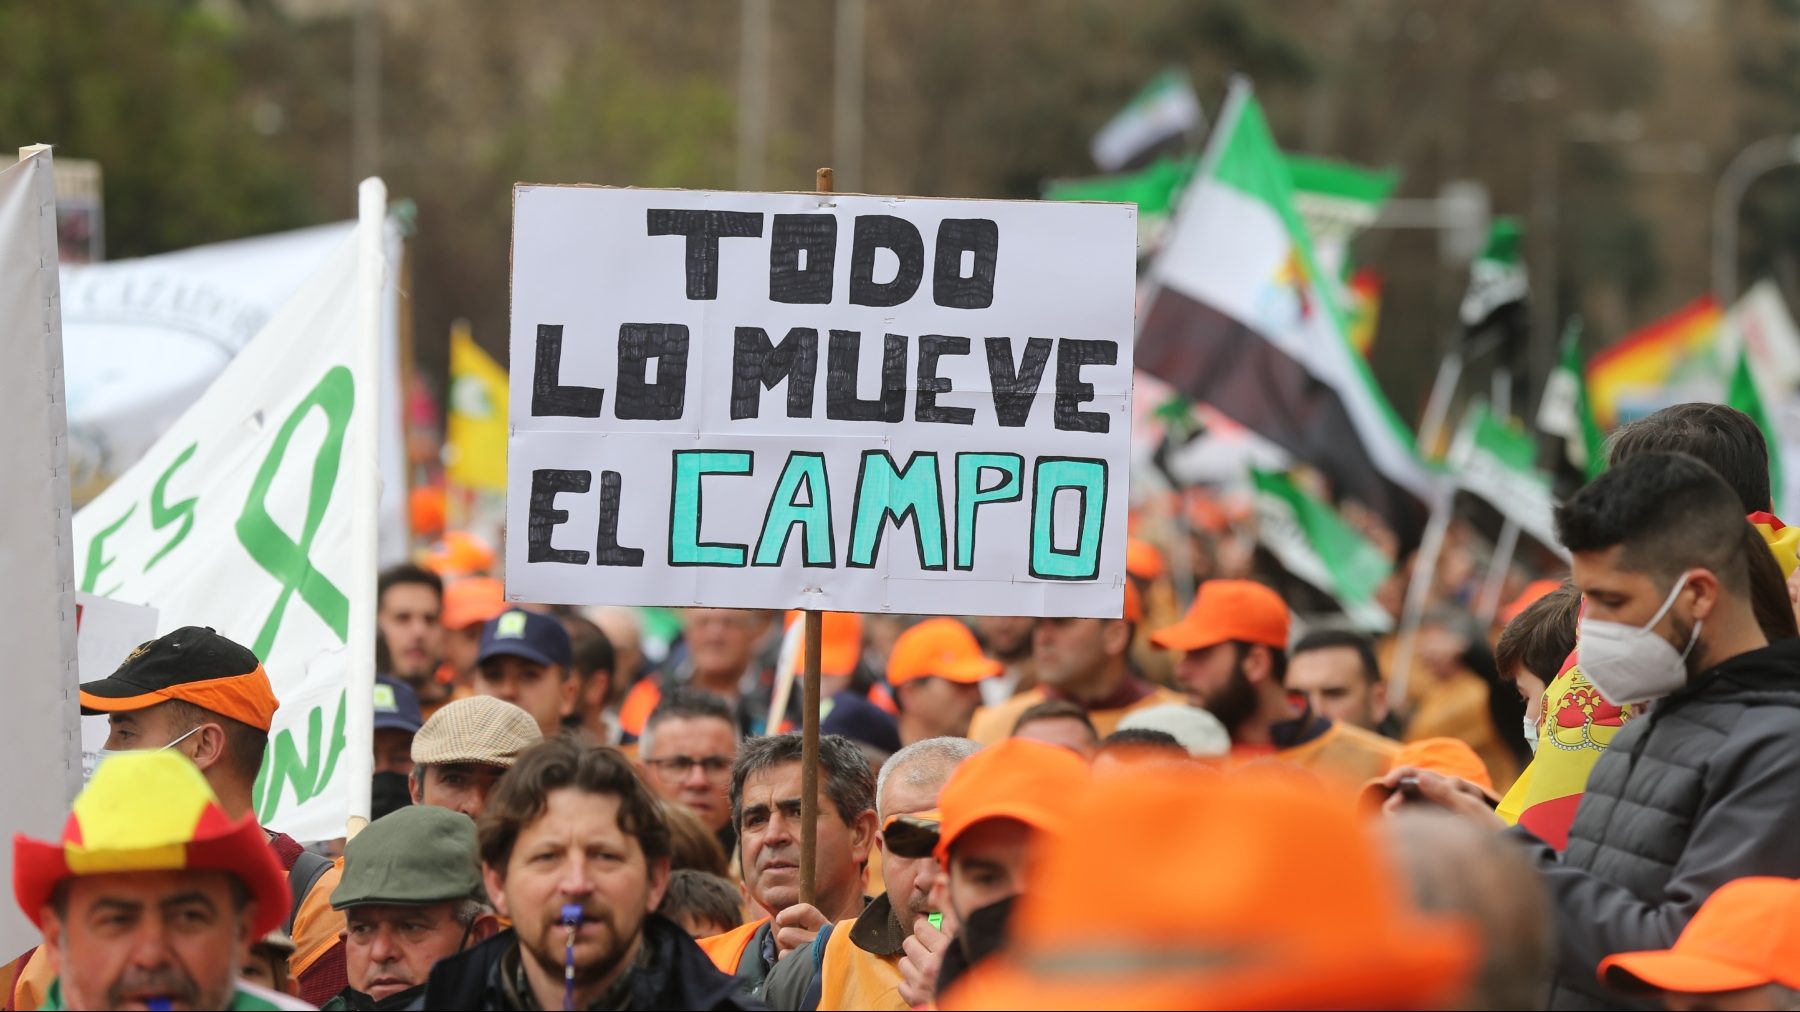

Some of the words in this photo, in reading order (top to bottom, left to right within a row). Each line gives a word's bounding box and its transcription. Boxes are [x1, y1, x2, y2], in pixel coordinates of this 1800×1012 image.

[647, 208, 999, 310] TODO
[531, 322, 690, 421] LO
[729, 326, 1119, 434] MUEVE
[527, 468, 645, 567] EL
[667, 448, 1109, 582] CAMPO
